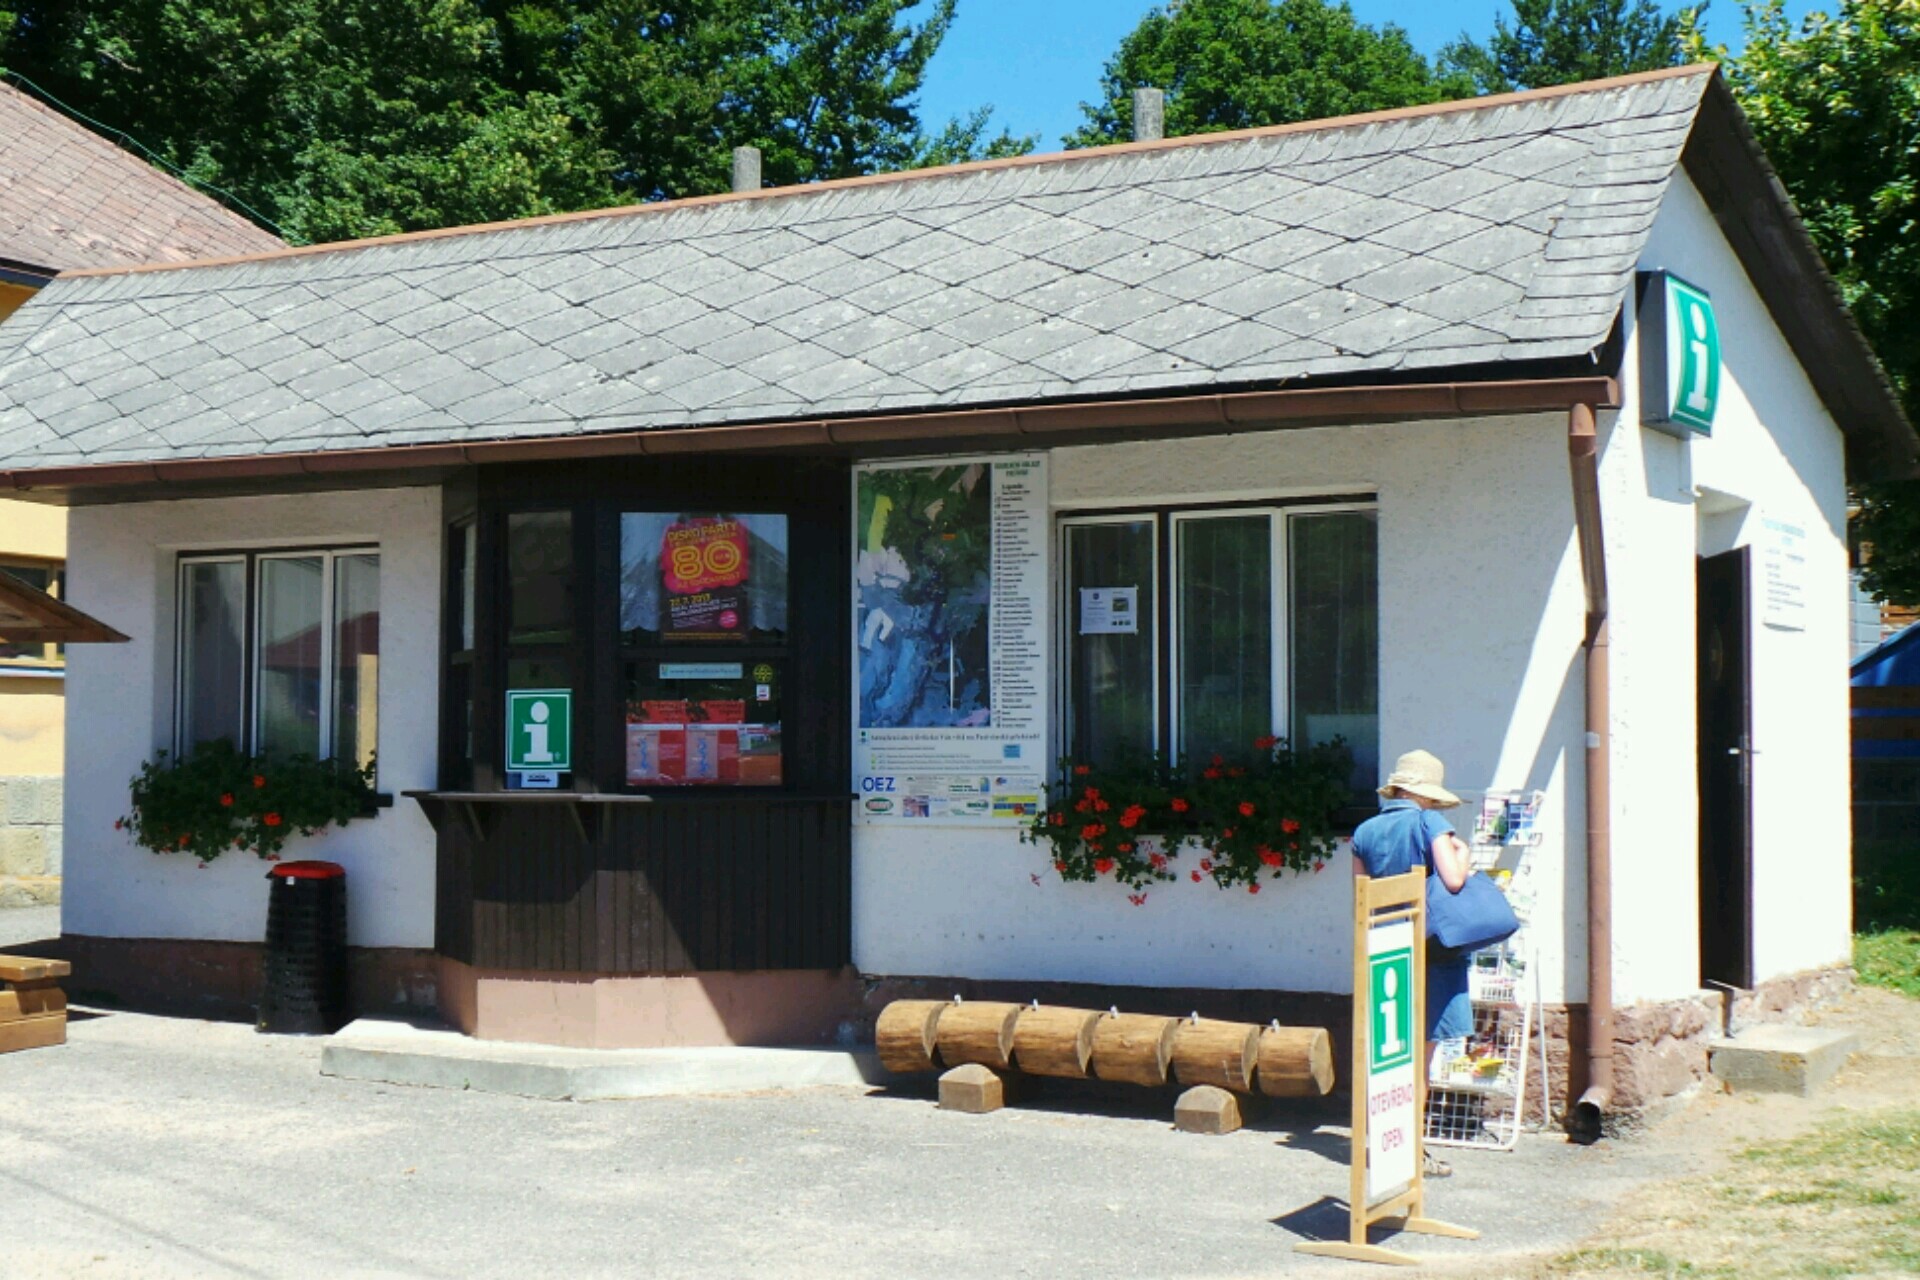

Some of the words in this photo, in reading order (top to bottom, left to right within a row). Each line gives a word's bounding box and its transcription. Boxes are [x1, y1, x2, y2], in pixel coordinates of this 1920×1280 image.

[701, 522, 737, 537] PARTY
[672, 540, 741, 580] 80
[863, 777, 896, 792] OEZ
[1370, 1083, 1413, 1116] OTEVŘENO
[1381, 1127, 1404, 1152] OPEN
